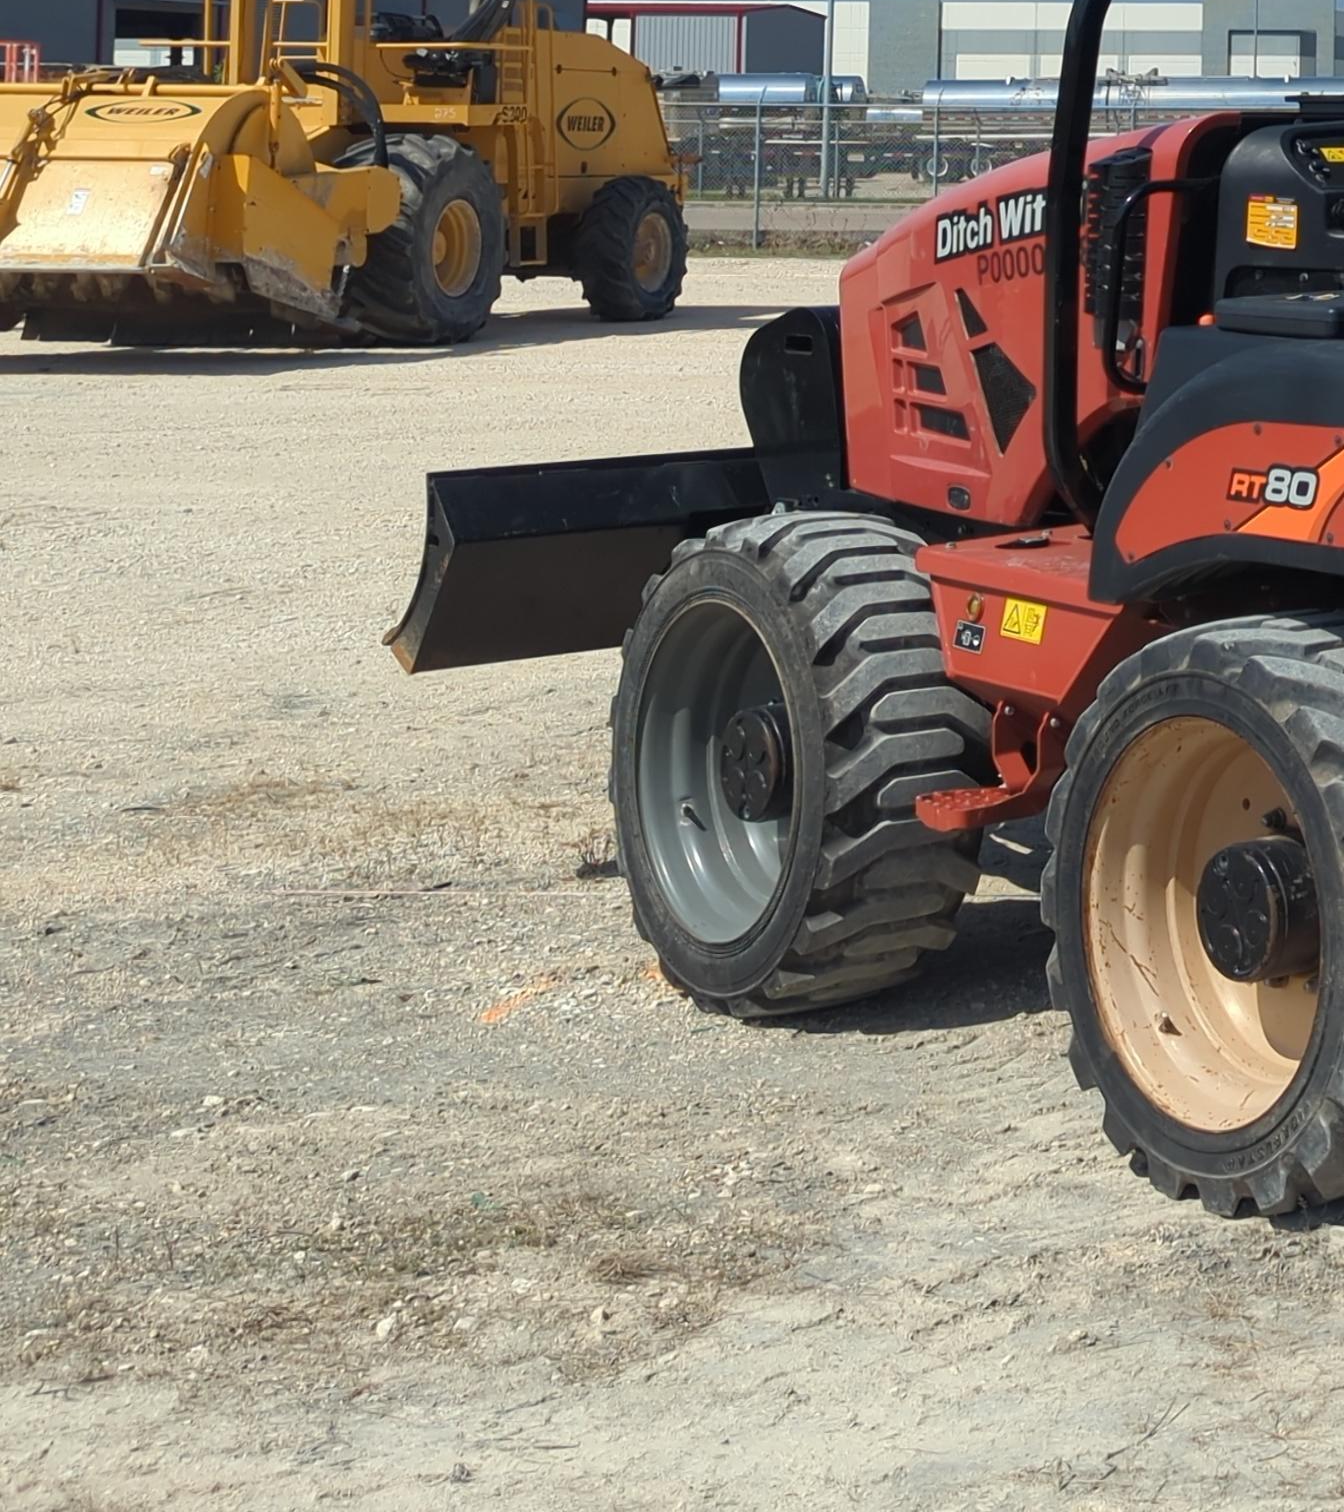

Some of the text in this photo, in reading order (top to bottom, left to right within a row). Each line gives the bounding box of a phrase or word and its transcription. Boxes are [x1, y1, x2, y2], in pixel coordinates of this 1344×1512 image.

[106, 107, 181, 116] WEILER
[566, 115, 605, 132] WEILER
[936, 206, 994, 259] Ditch
[1229, 467, 1318, 506] RT80
